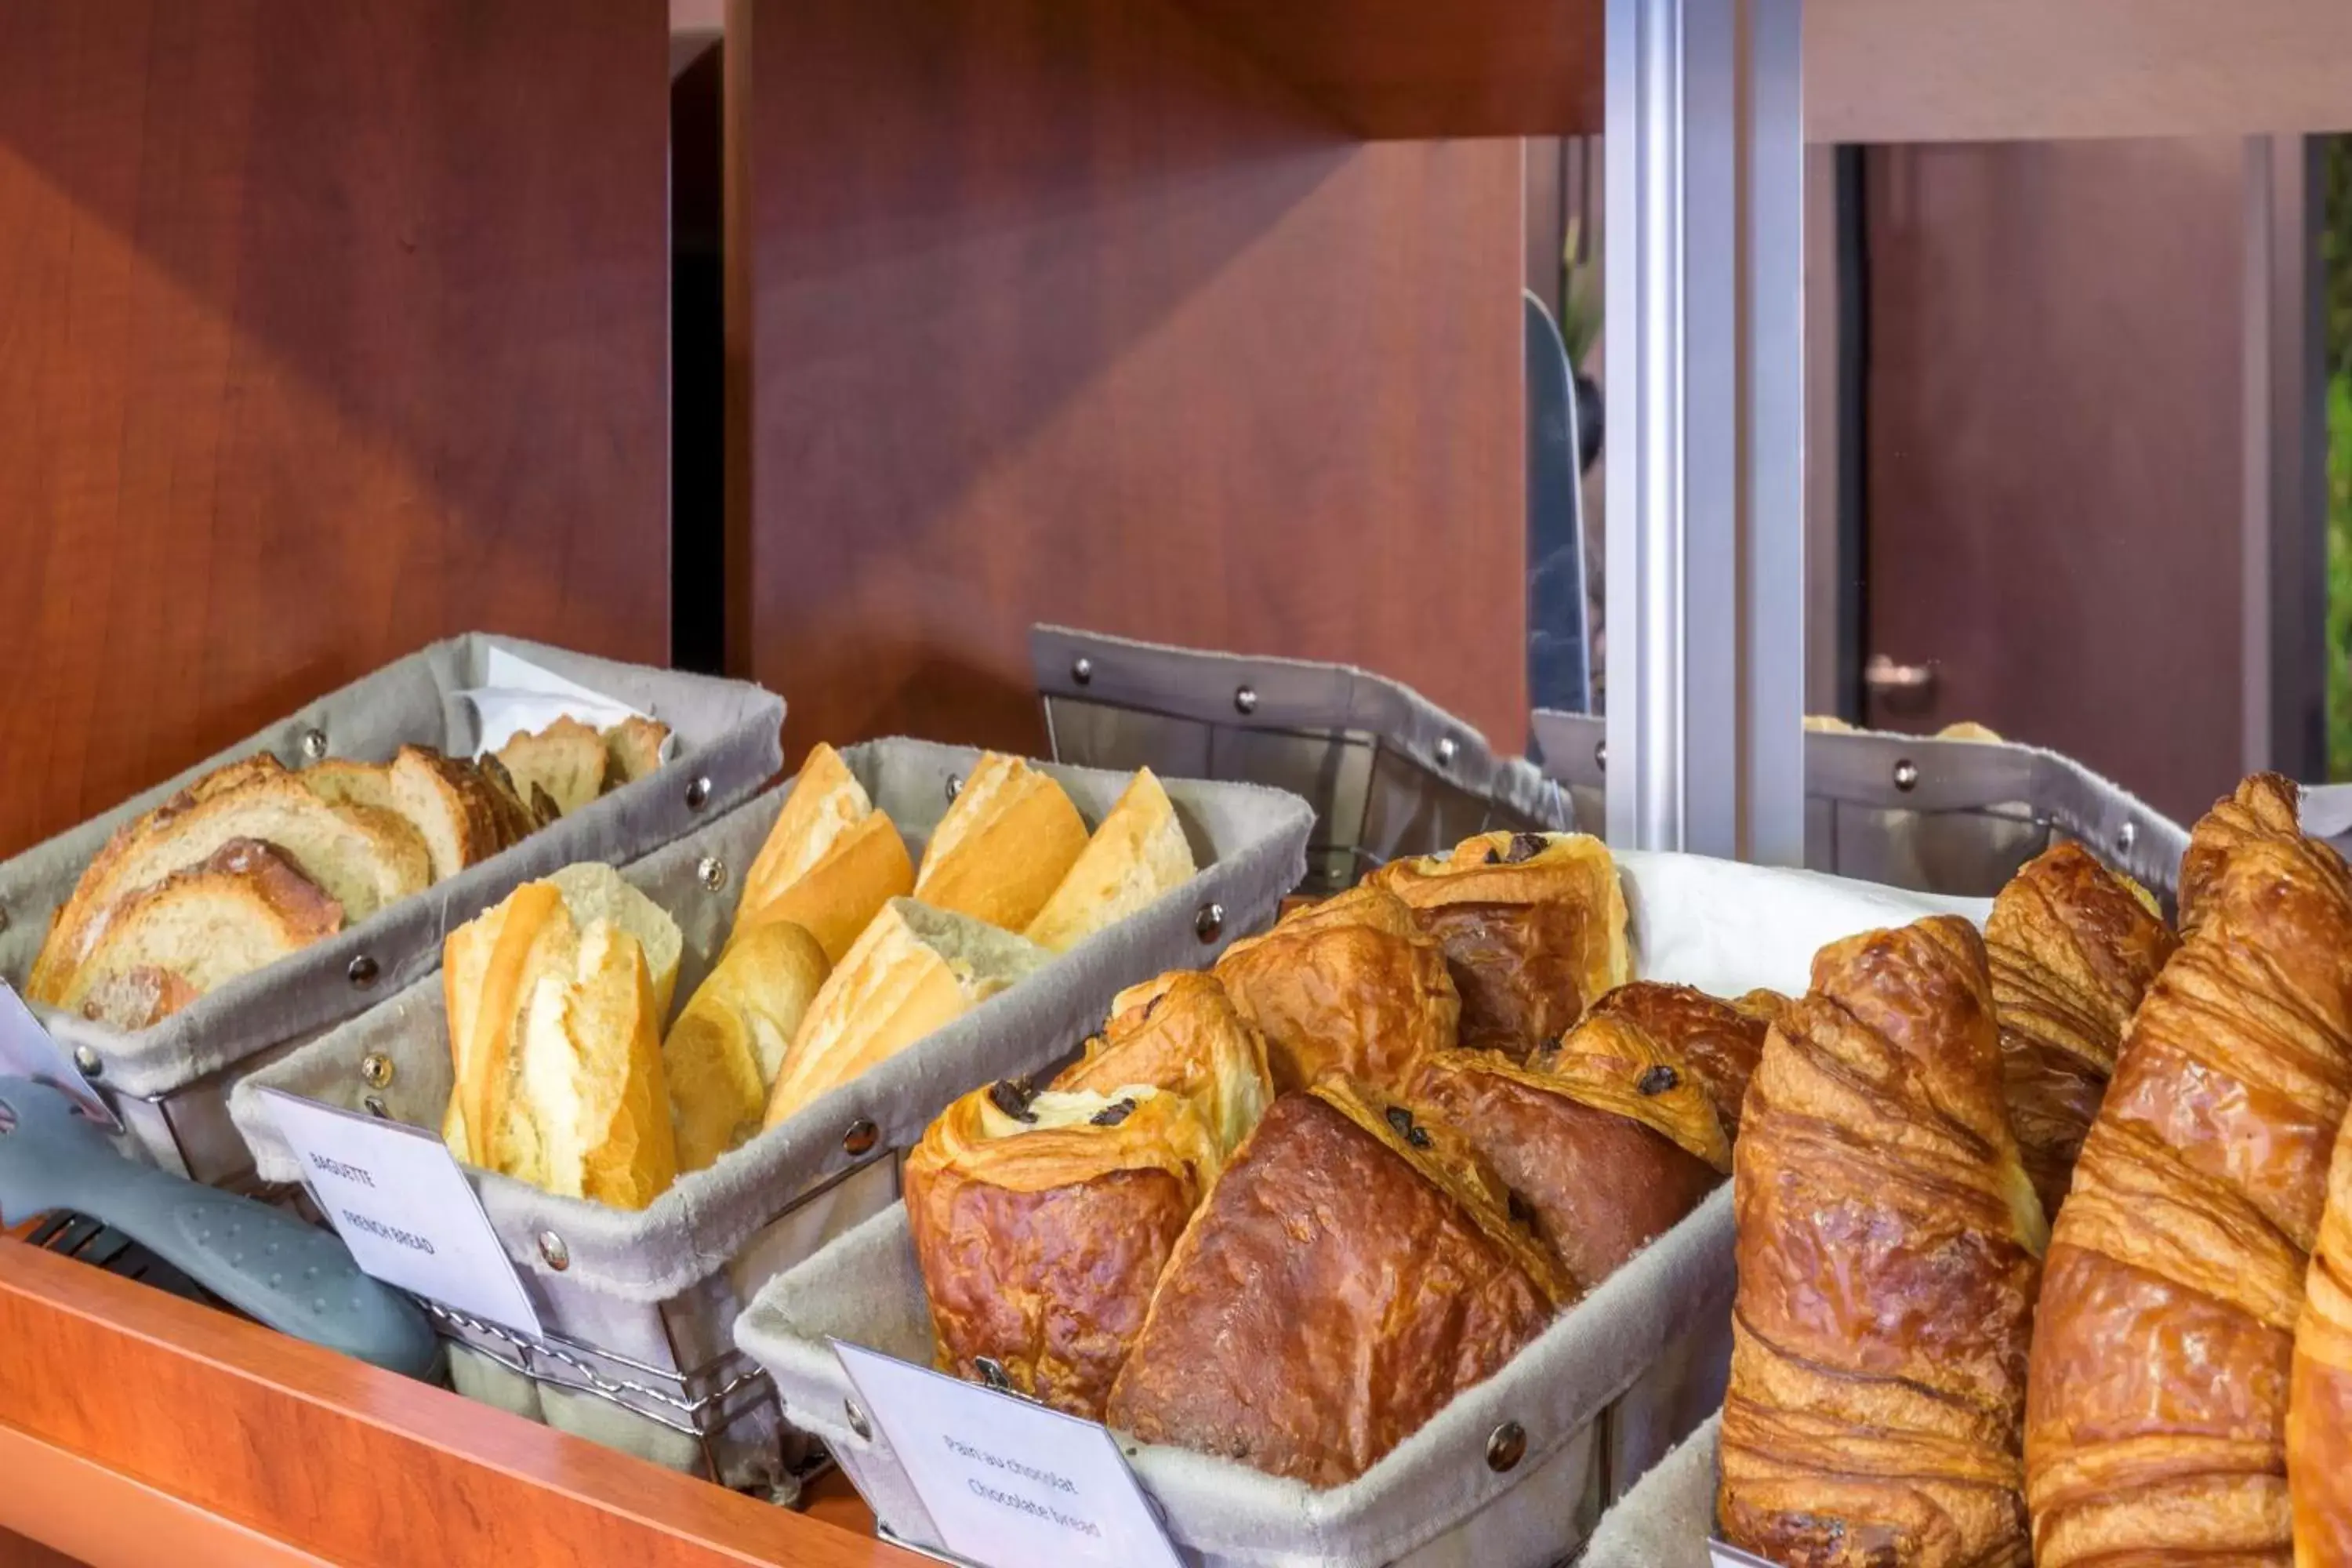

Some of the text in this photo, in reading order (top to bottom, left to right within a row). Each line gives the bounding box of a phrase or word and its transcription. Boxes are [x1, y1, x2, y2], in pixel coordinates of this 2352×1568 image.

[309, 1151, 376, 1189] BAGUETTE
[342, 1208, 434, 1255] FRENCH BREAD
